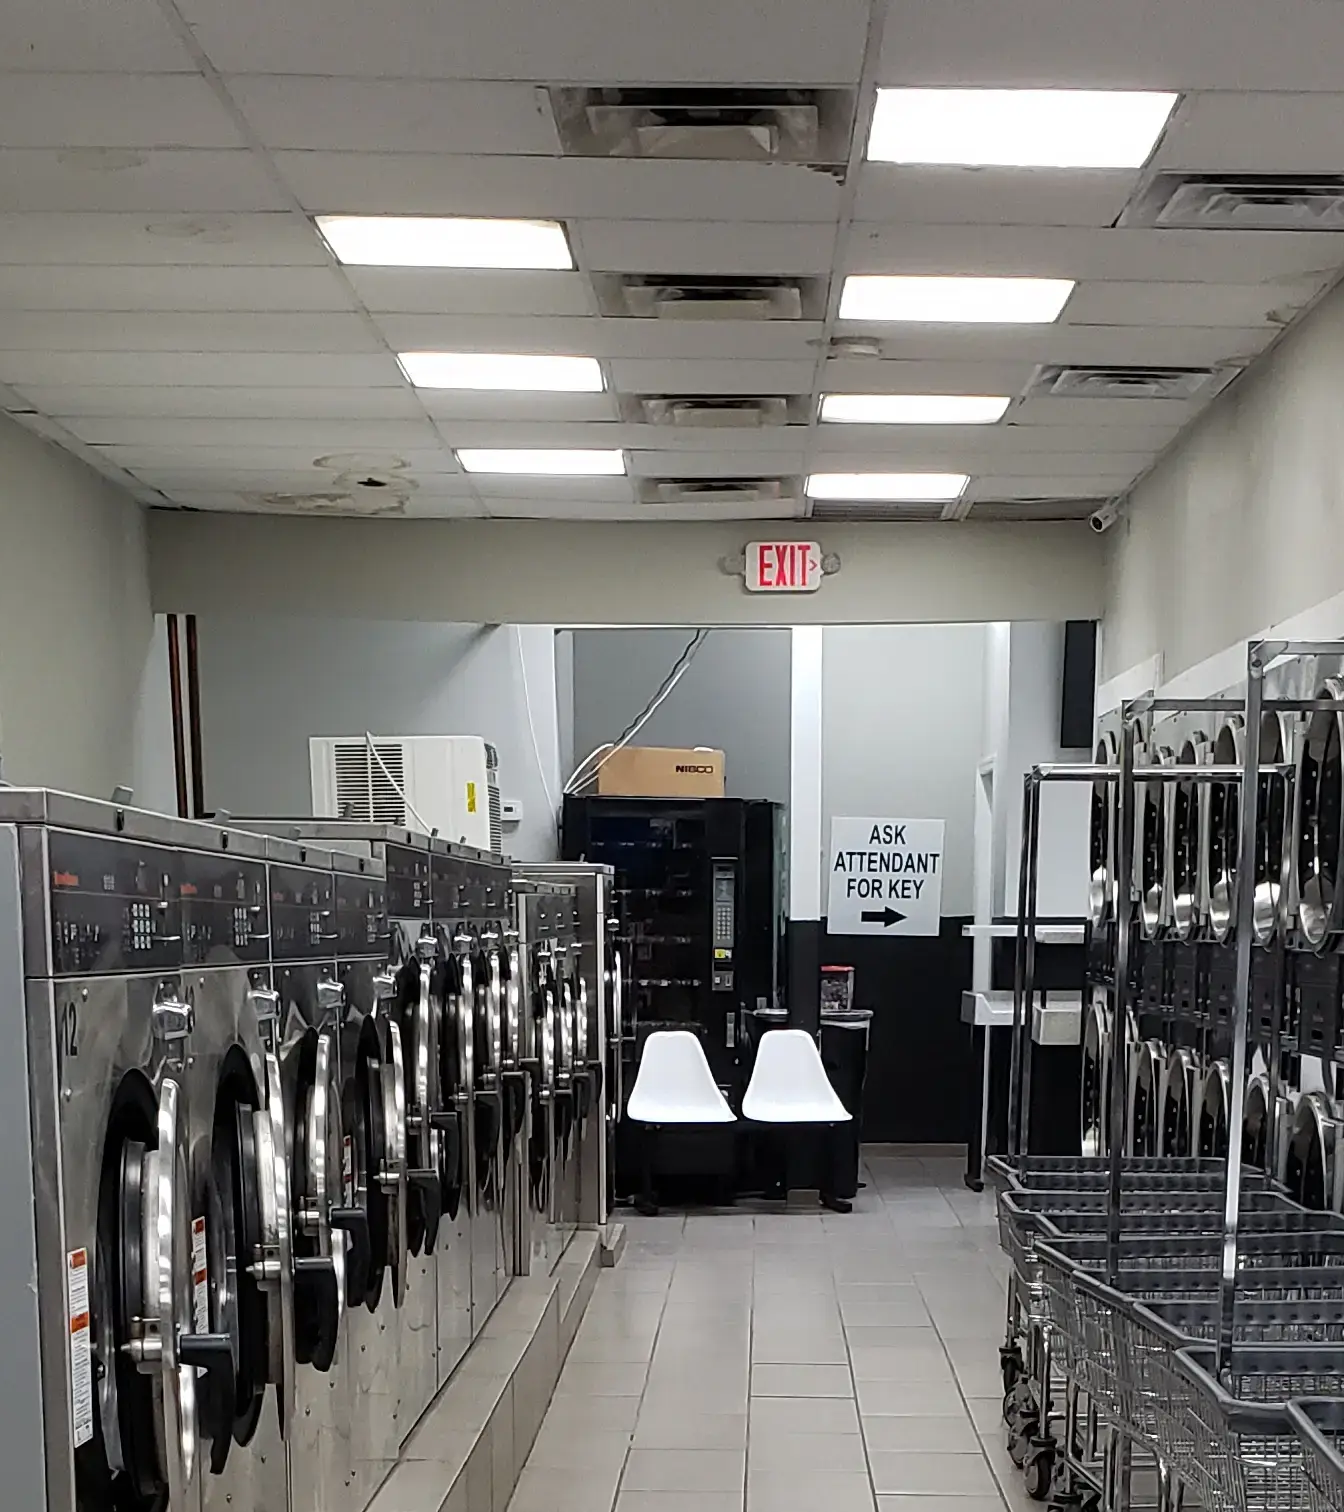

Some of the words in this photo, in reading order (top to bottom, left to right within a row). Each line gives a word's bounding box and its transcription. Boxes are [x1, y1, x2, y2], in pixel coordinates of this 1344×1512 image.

[759, 545, 811, 586] EXIT
[869, 824, 906, 844] ASK
[834, 851, 940, 873] ATTENDANT
[847, 878, 882, 898] FOR
[889, 879, 924, 899] KEY
[61, 1002, 77, 1056] 12
